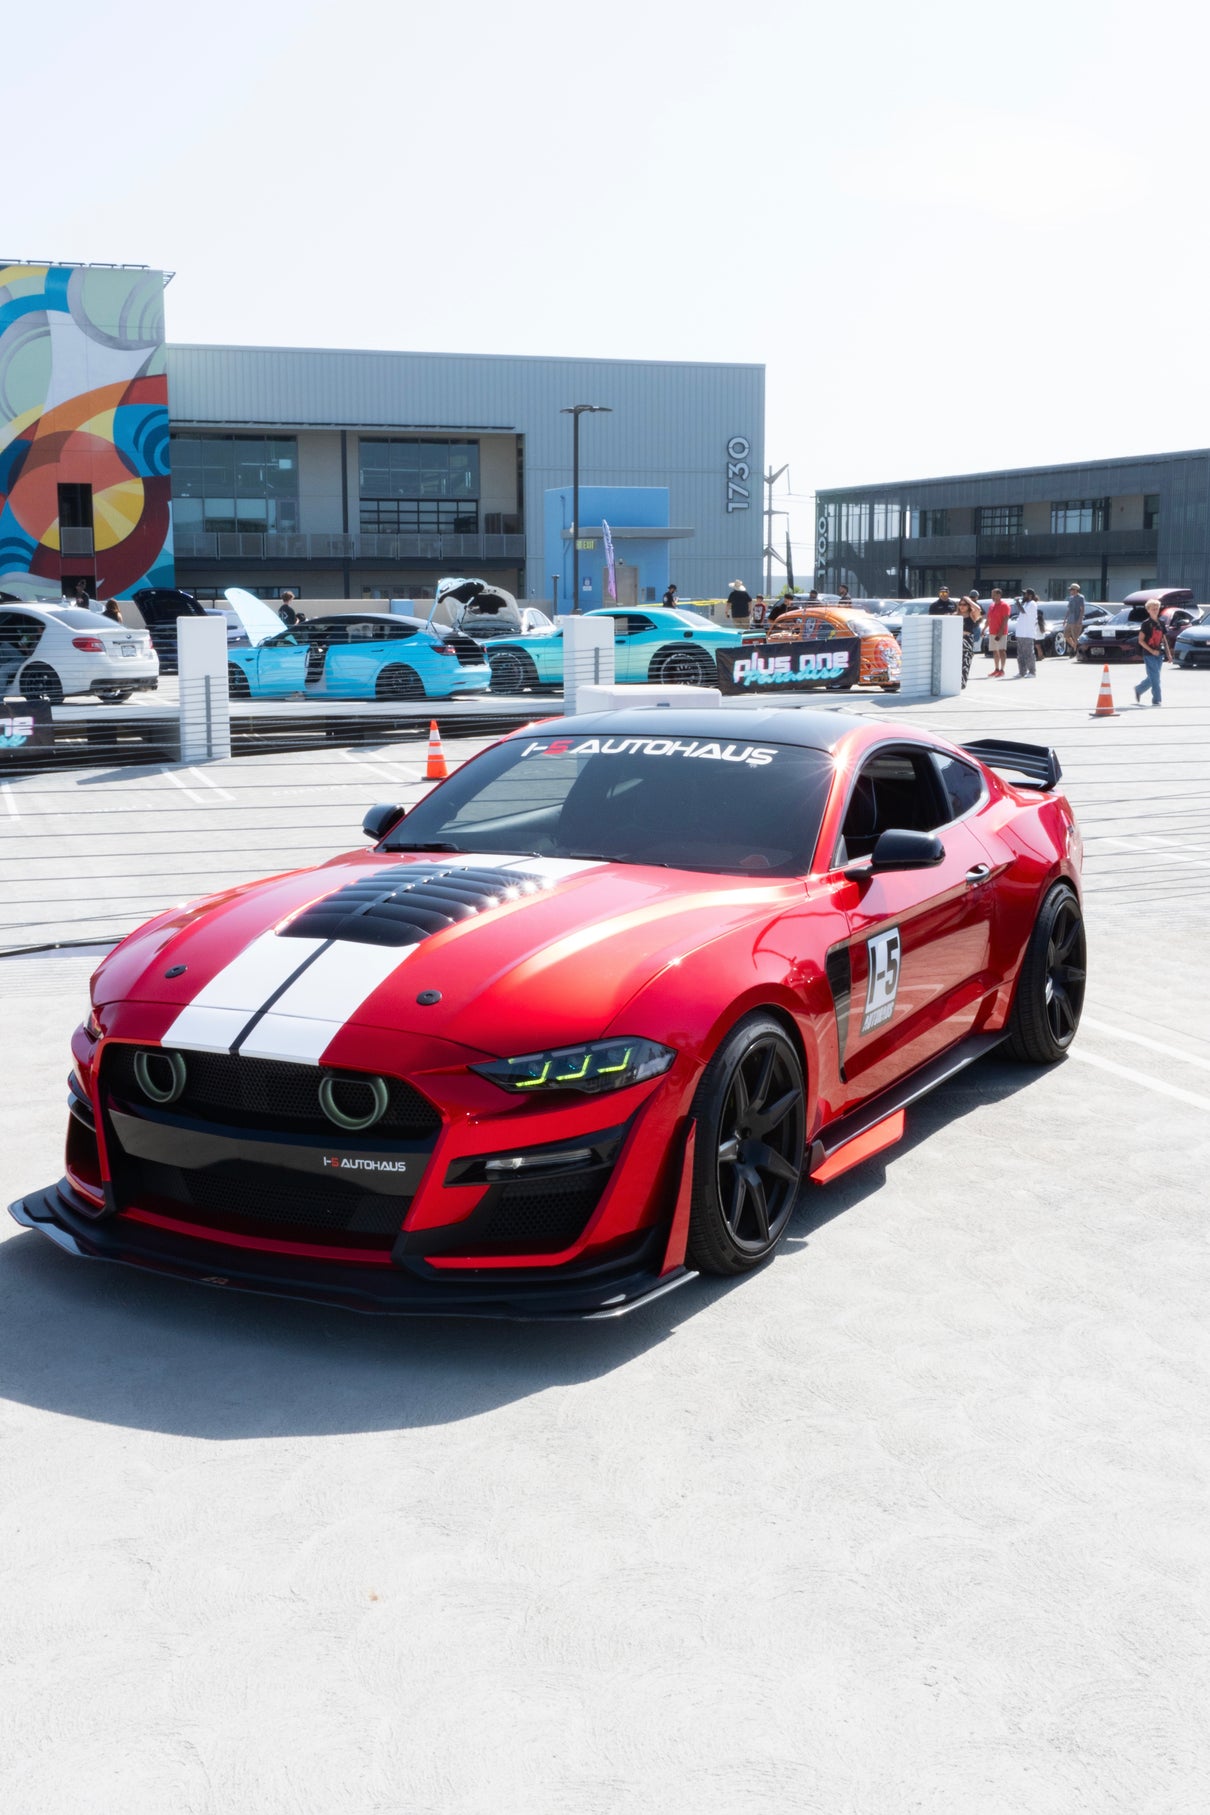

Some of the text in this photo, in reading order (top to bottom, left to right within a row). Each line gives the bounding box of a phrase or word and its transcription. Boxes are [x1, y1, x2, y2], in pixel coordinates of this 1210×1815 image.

[727, 436, 750, 514] 1730
[733, 651, 849, 683] plus one
[569, 738, 778, 765] AUTOHAUS
[340, 1158, 407, 1172] AUTOHAUS
